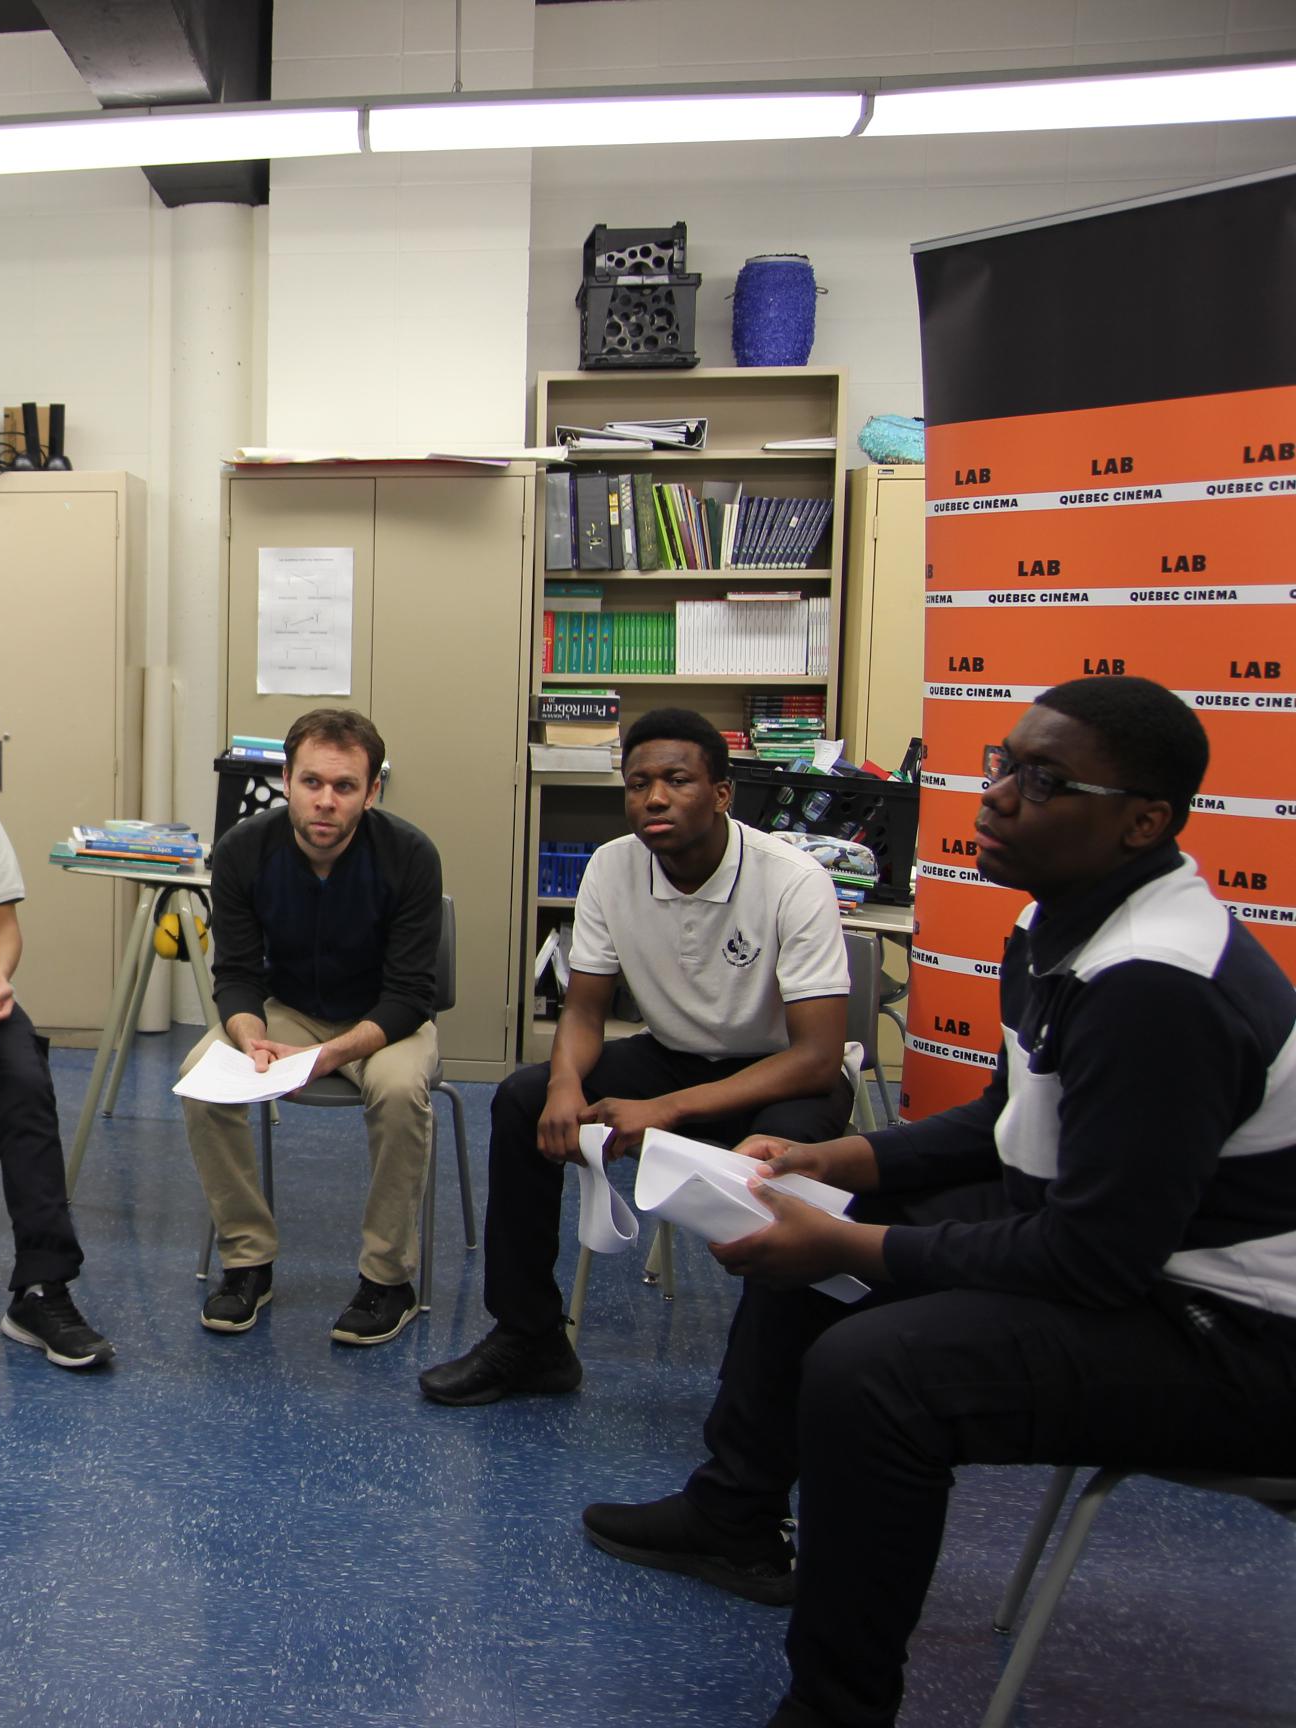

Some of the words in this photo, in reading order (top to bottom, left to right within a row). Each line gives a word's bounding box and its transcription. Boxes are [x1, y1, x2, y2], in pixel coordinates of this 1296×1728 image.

[1243, 443, 1295, 464] LAB
[1091, 456, 1134, 476] LAB
[954, 467, 991, 486] LAB
[1059, 492, 1110, 505] QUÉBEC
[1113, 489, 1162, 503] CINÉMA
[1206, 481, 1264, 496] QUÉBEC
[933, 500, 971, 513] QUÉBEC
[973, 498, 1018, 511] CINÉMA
[1018, 560, 1061, 577] LAB
[1161, 555, 1207, 573] LAB
[988, 593, 1036, 604] QUÉBEC
[1039, 590, 1089, 603] CINÉMA
[1129, 589, 1180, 602] QUÉBEC
[1184, 588, 1237, 601] CINÉMA
[949, 656, 984, 673] LAB
[1083, 658, 1126, 675] LAB
[1230, 661, 1281, 679] LAB
[929, 685, 963, 697] QUÉBEC
[966, 685, 1012, 699] CINÉMA
[1195, 695, 1250, 707] QUÉBEC
[1255, 696, 1296, 708] CINÉ
[942, 838, 978, 856] LAB
[922, 864, 956, 878] QUÉBEC
[959, 870, 985, 882] CIN
[1218, 869, 1267, 890] LAB
[1242, 907, 1296, 922] CINÉM
[974, 963, 1001, 976] QUÉ
[934, 1015, 971, 1036] LAB
[913, 1039, 949, 1056] QUÉBEC
[952, 1049, 997, 1067] CINÉMA
